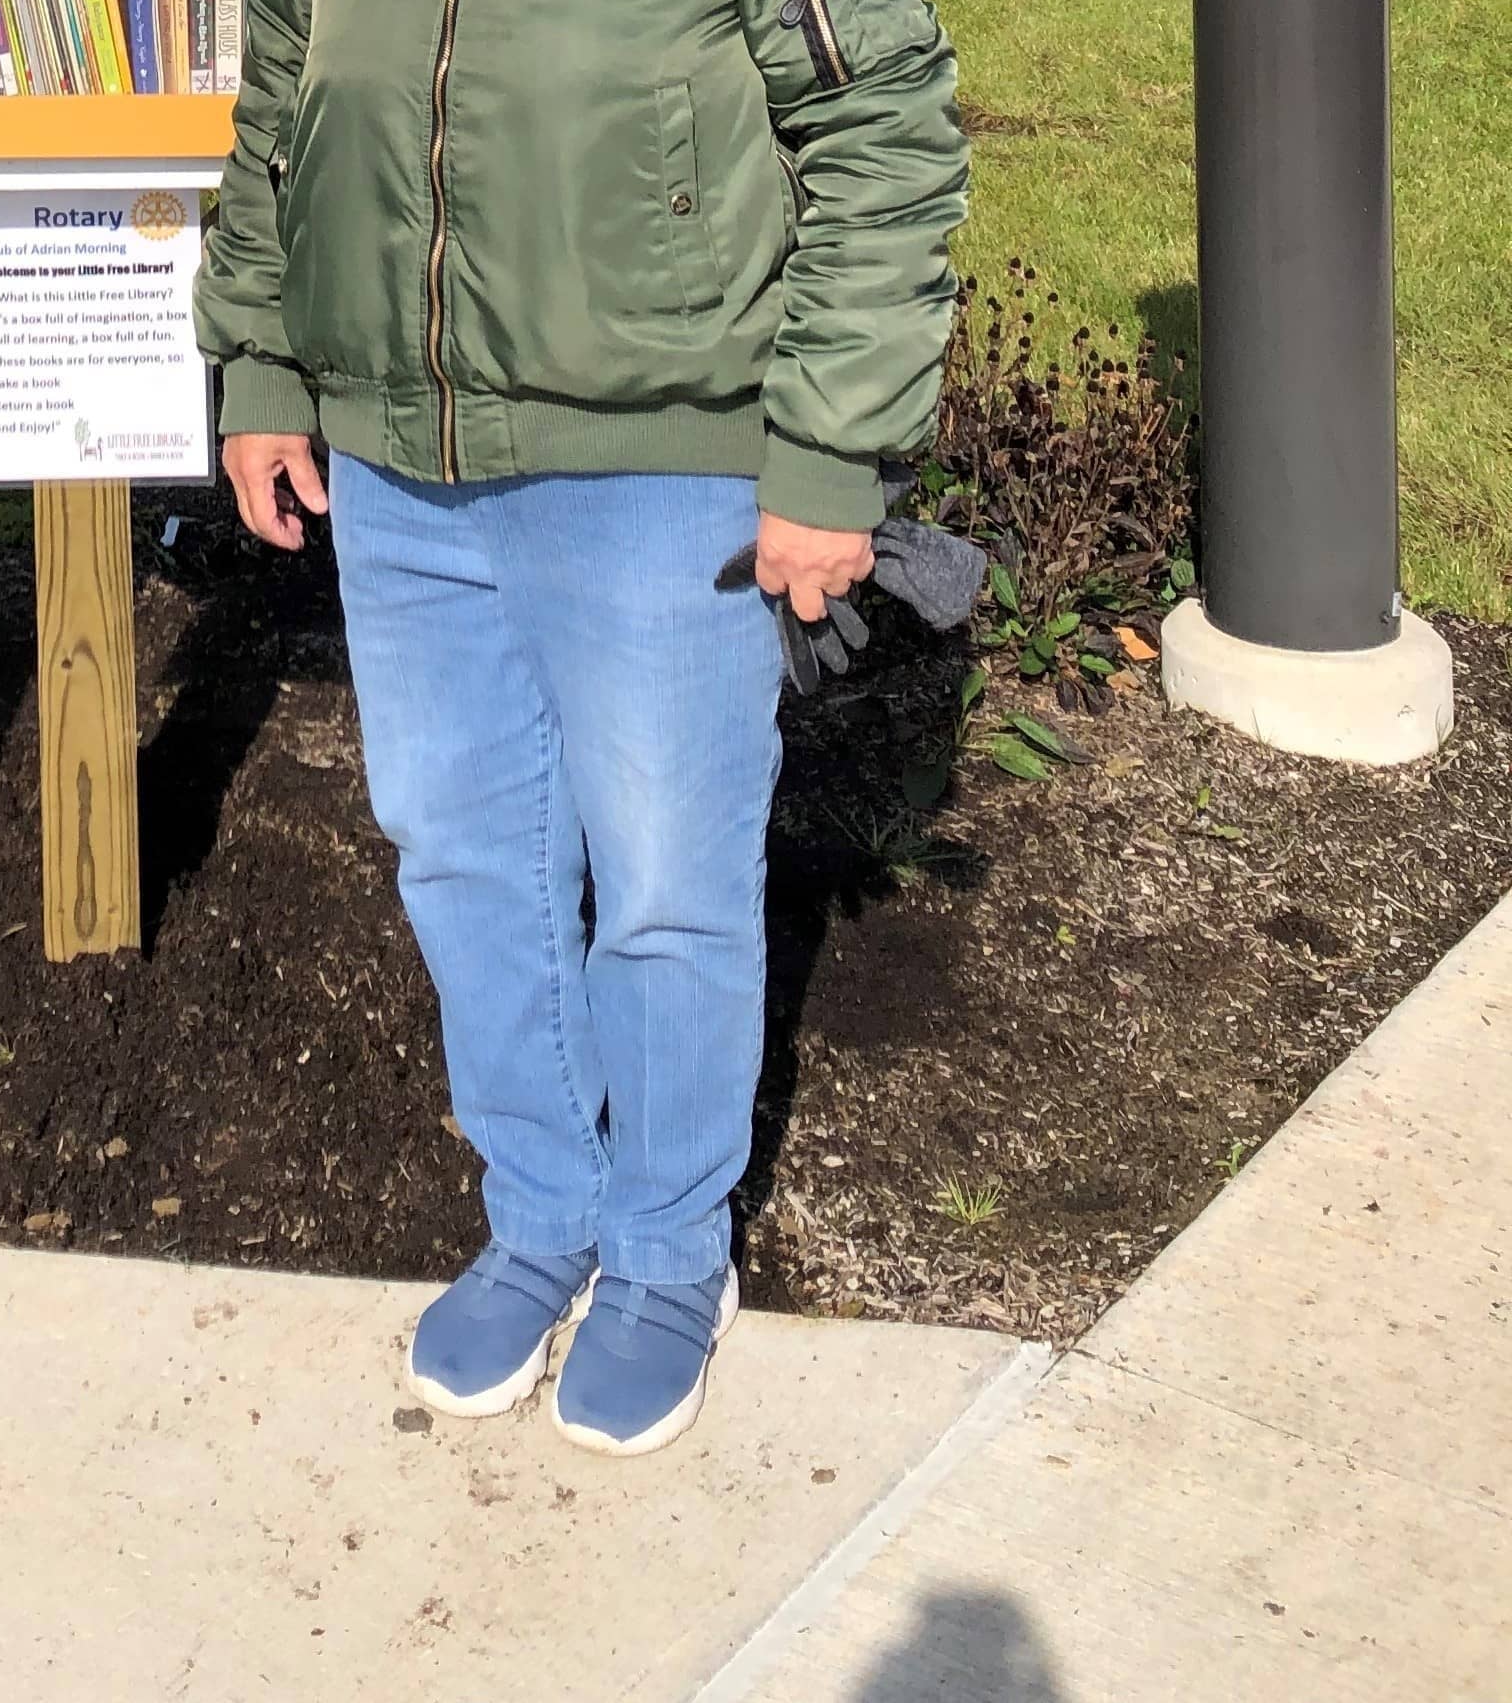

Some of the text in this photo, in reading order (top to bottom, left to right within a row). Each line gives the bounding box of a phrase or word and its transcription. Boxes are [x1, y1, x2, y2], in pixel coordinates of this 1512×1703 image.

[219, 24, 238, 60] HOUSE
[34, 207, 123, 231] Rotary
[15, 244, 27, 256] of
[31, 244, 71, 255] Adrian
[75, 242, 127, 256] Morning
[39, 266, 49, 277] to
[51, 267, 75, 279] your
[78, 264, 104, 276] Little
[107, 264, 130, 275] Free
[132, 261, 173, 275] Library!
[32, 291, 40, 302] is
[44, 291, 64, 302] this
[68, 290, 96, 301] Little
[100, 290, 125, 301] Free
[128, 288, 173, 301] Library?
[11, 316, 18, 324] a
[21, 313, 41, 324] box
[45, 312, 63, 324] full
[67, 312, 79, 323] of
[82, 311, 153, 325] imagination,
[157, 312, 163, 321] a
[167, 310, 188, 321] box
[13, 333, 24, 344] of
[28, 333, 78, 346] learning,
[81, 335, 88, 343] a
[92, 331, 112, 343] box
[116, 331, 133, 342] full
[137, 330, 149, 341] of
[152, 330, 174, 341] fun.
[29, 354, 63, 367] books
[67, 356, 85, 366] are
[88, 354, 103, 365] for
[107, 354, 164, 366] everyone,
[22, 380, 29, 389] a
[32, 377, 61, 389] book
[36, 402, 42, 411] a
[46, 398, 74, 411] book
